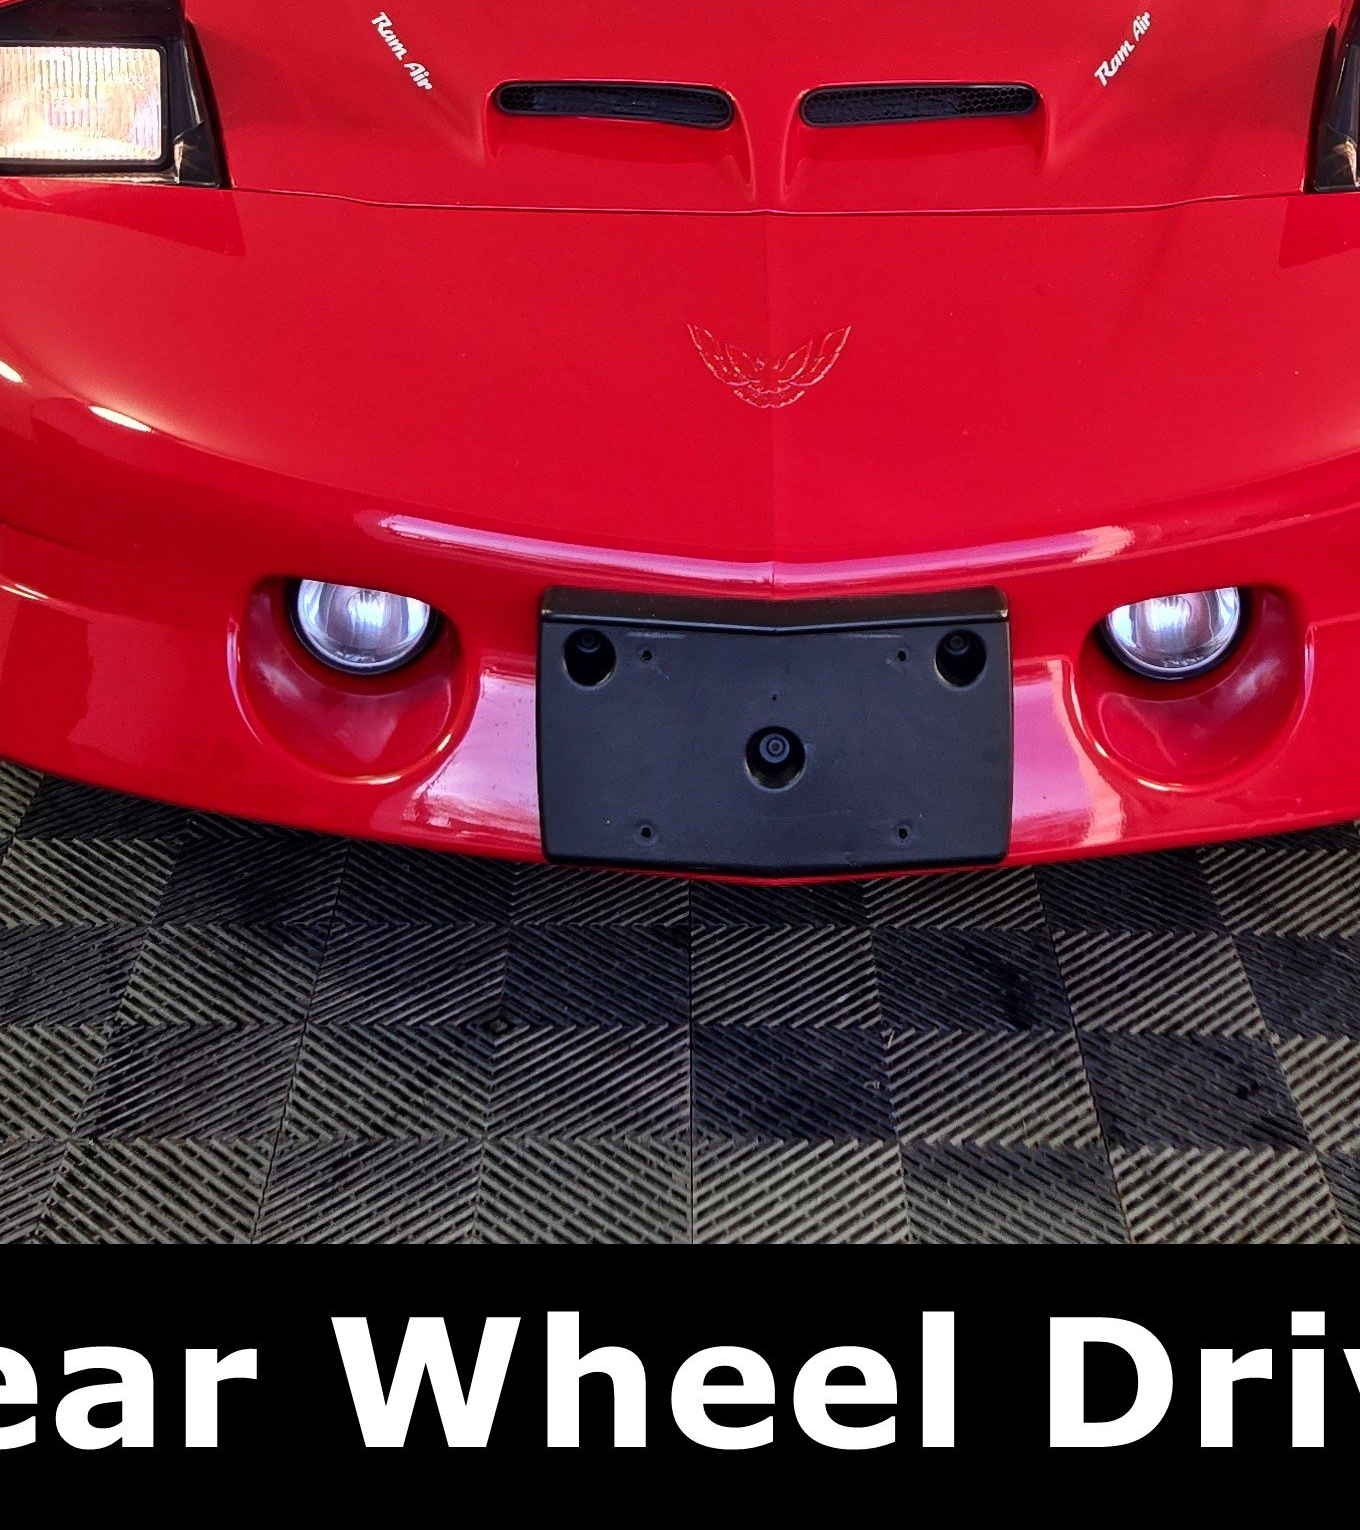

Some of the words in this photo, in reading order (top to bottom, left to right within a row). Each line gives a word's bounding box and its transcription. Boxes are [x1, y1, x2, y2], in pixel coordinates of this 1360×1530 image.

[371, 11, 408, 61] Ram
[403, 62, 433, 90] Air
[1093, 39, 1136, 87] Ram
[1133, 11, 1151, 42] Air
